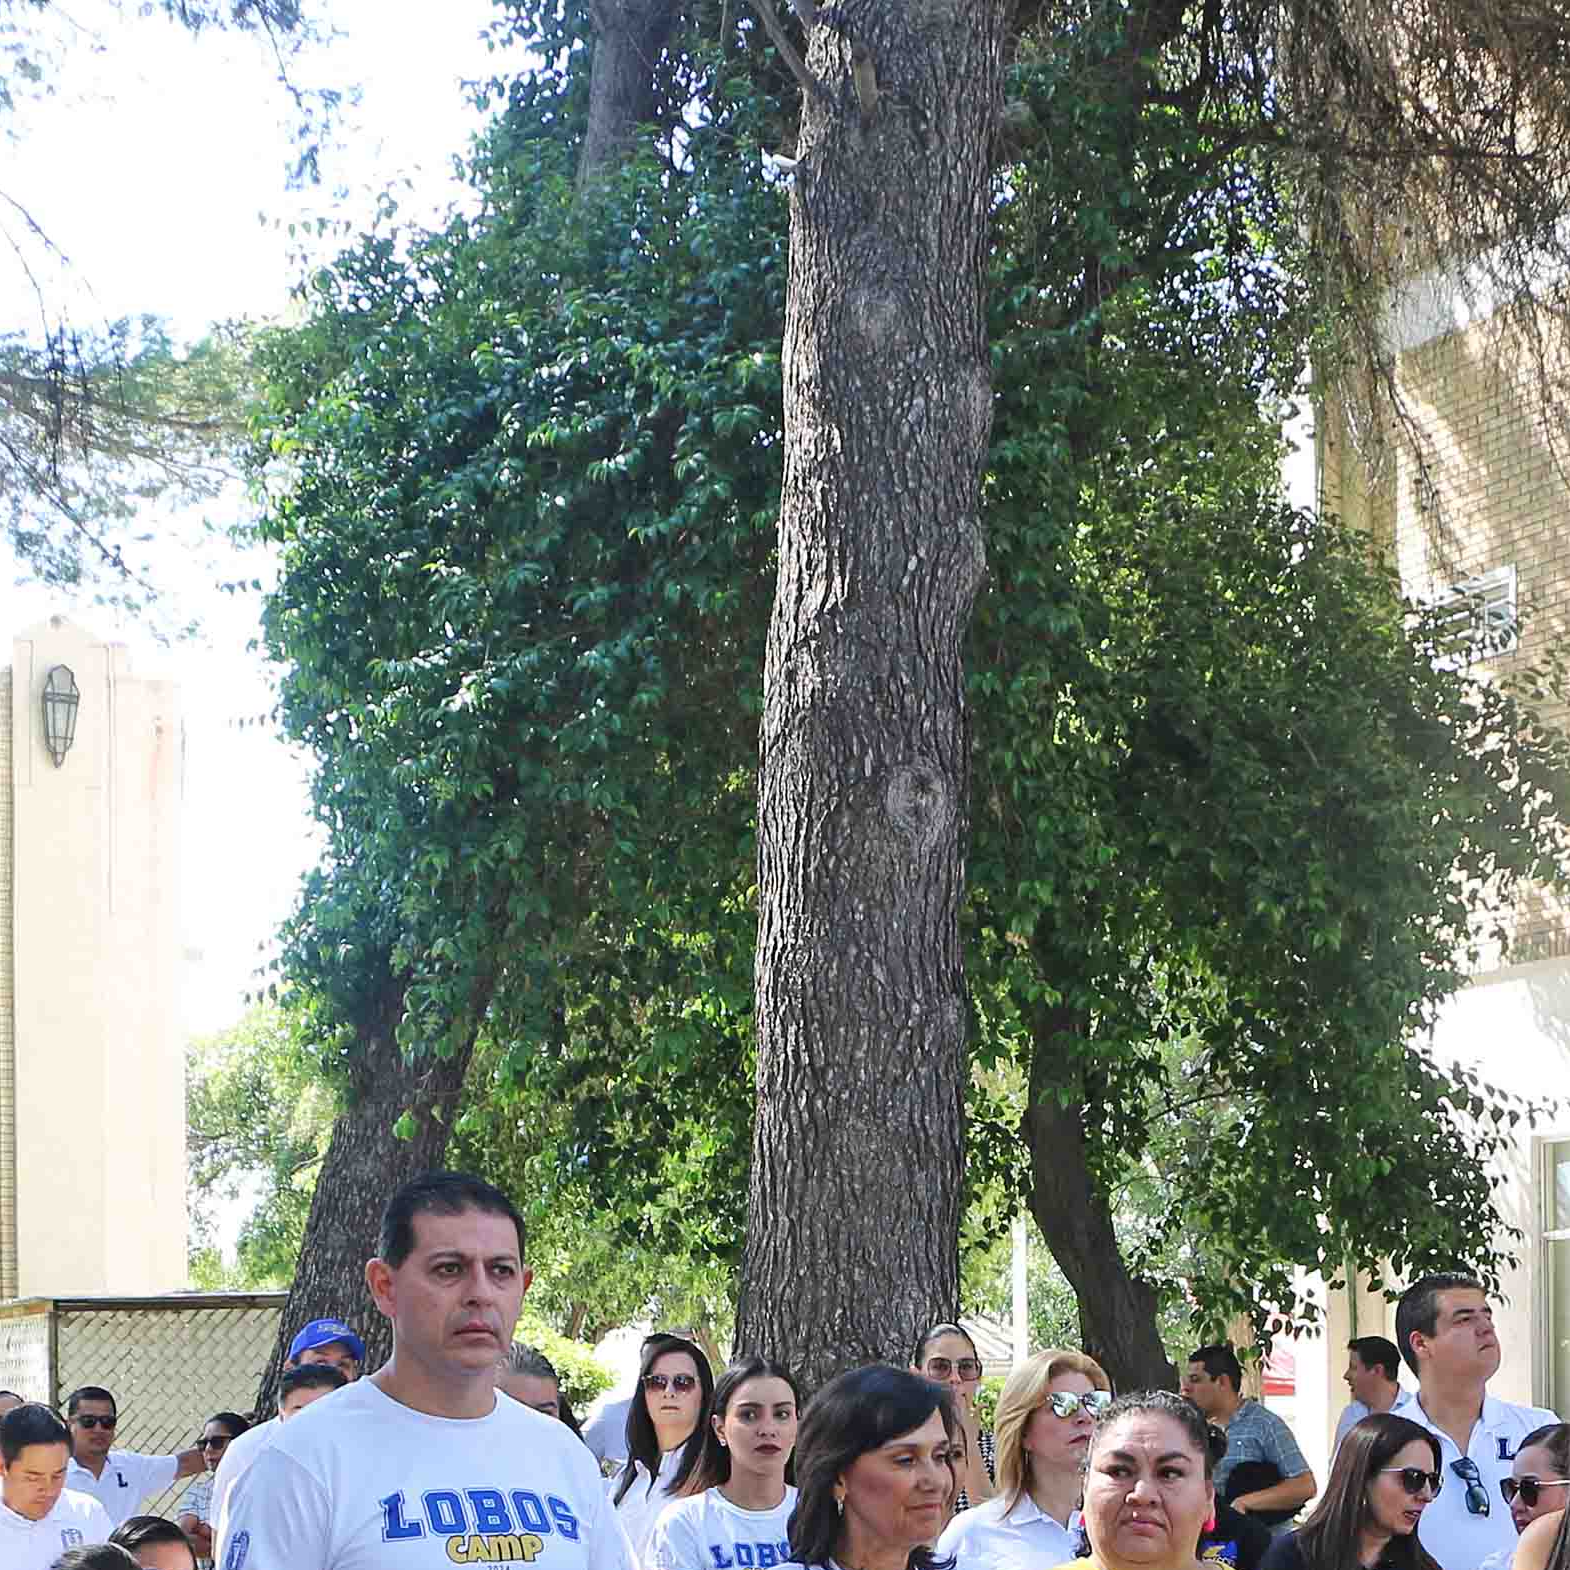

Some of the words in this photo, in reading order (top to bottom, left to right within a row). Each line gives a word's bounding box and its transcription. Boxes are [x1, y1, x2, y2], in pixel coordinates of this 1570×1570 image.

[116, 1471, 129, 1489] L
[379, 1487, 582, 1544] LOBOS
[445, 1533, 545, 1564] CAMP
